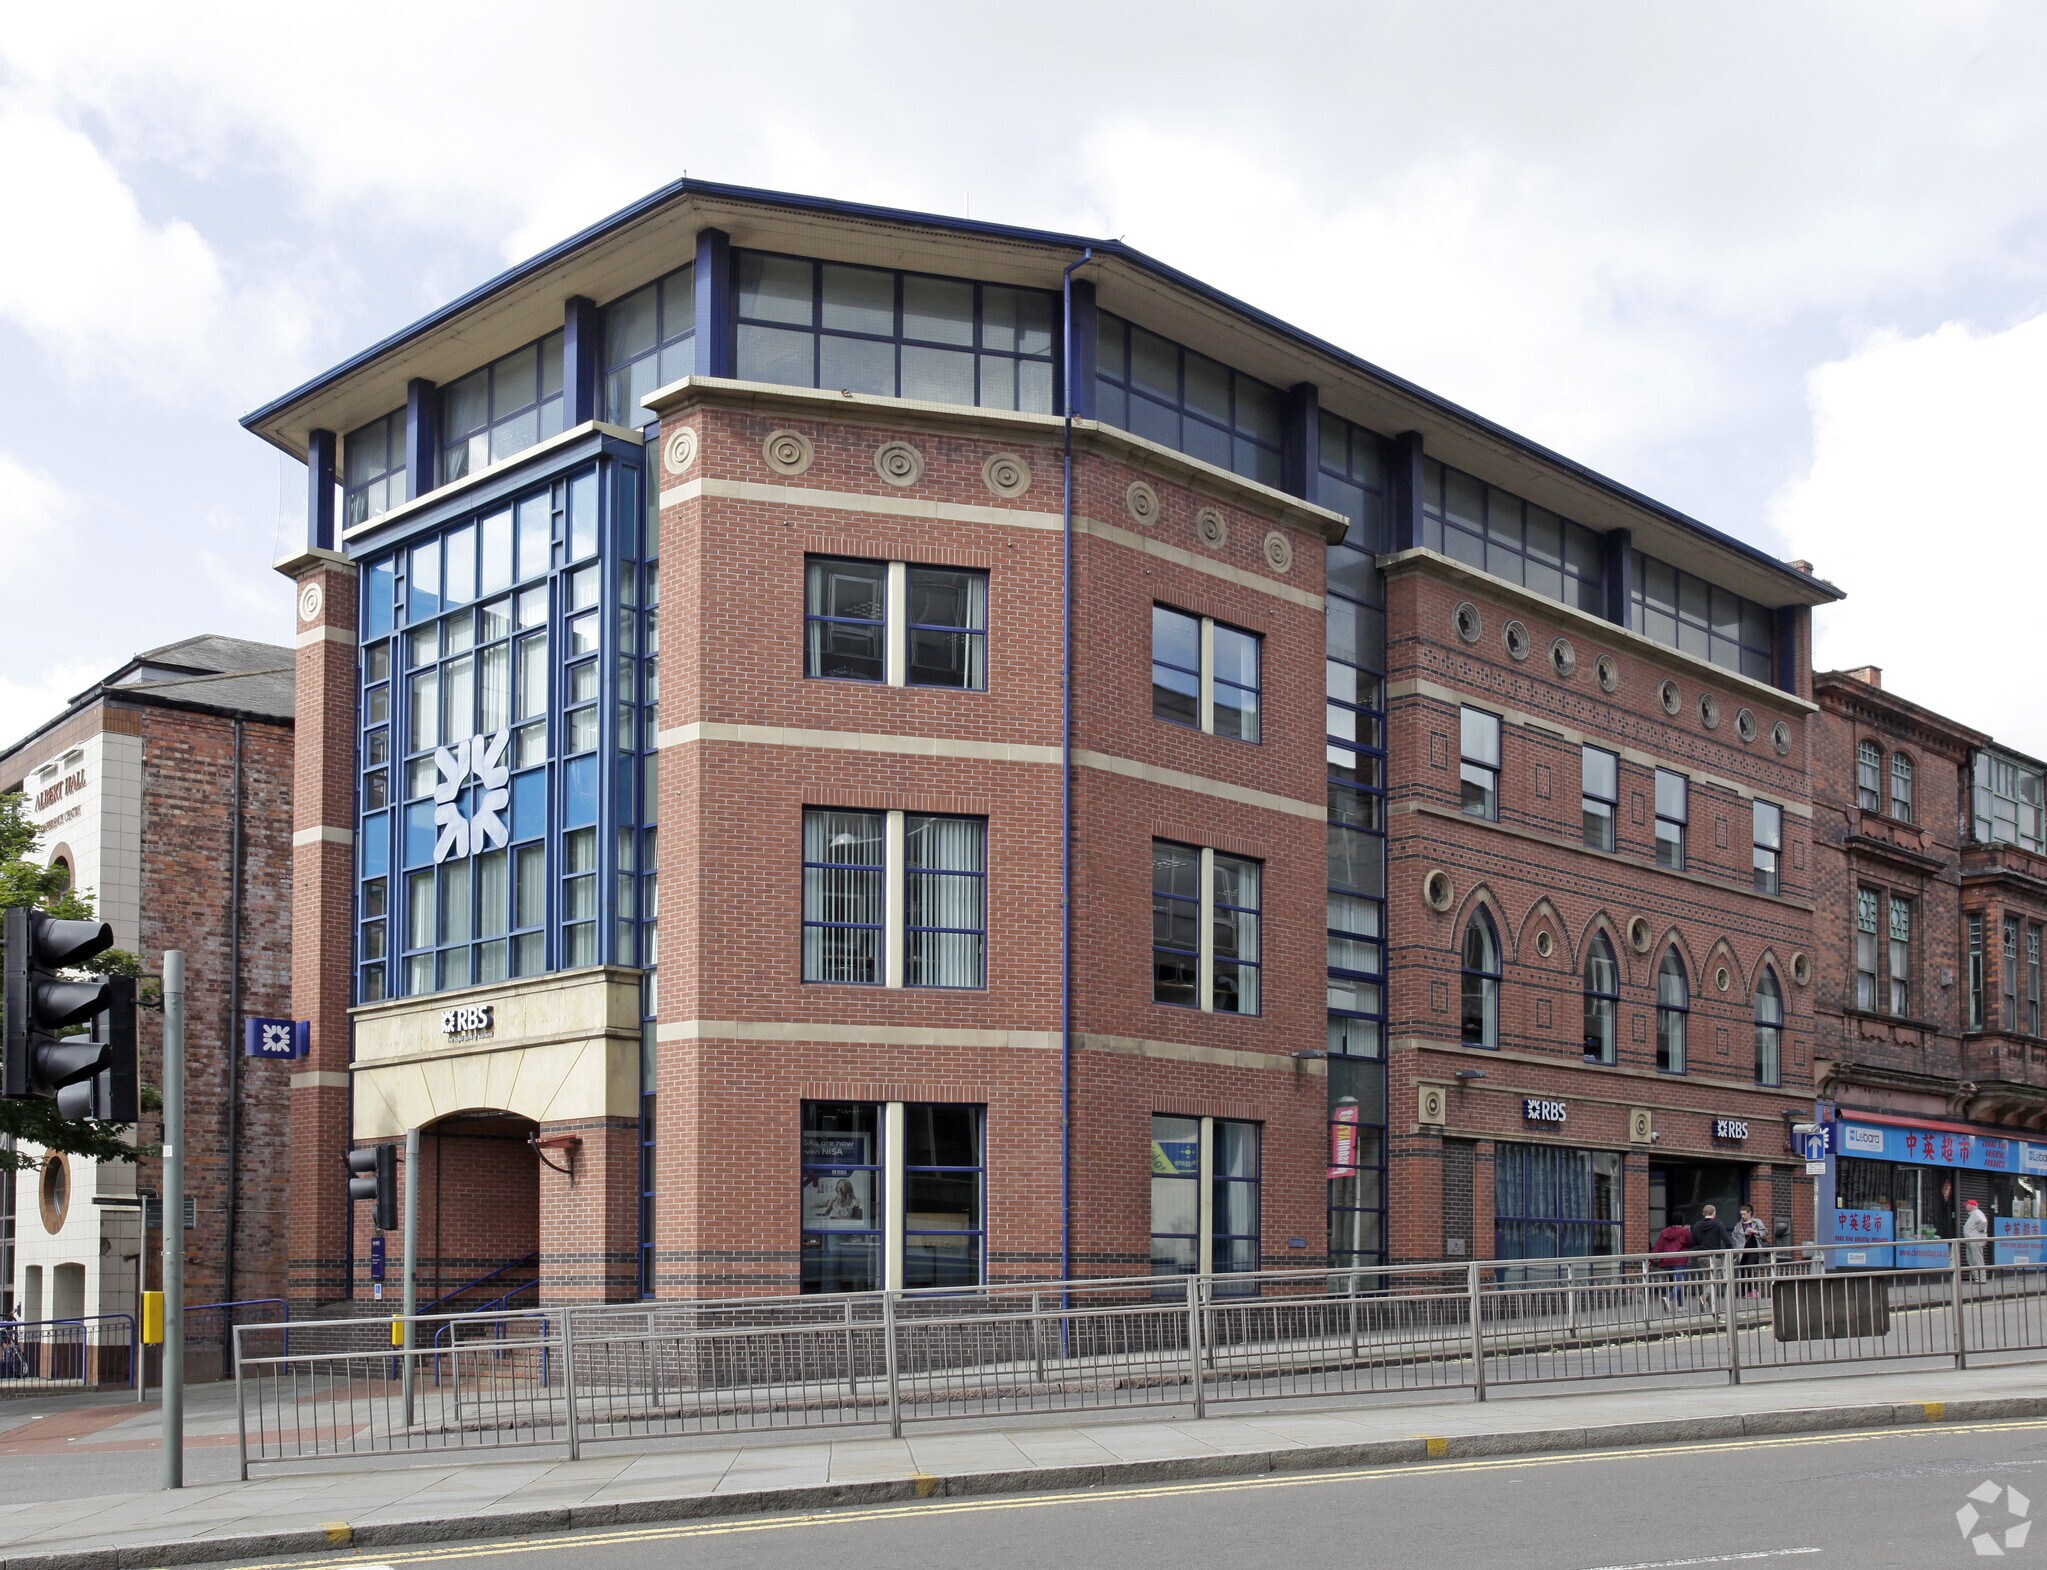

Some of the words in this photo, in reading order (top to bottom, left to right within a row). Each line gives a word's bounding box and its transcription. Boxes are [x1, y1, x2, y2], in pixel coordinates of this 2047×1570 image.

[35, 780, 64, 813] ALBERT
[65, 769, 87, 796] HALL
[457, 1005, 490, 1032] RBS
[1541, 1101, 1567, 1122] RBS
[1728, 1120, 1749, 1139] RBS
[1855, 1130, 1880, 1144] Lebara
[821, 1148, 844, 1156] NISA
[1906, 1129, 1971, 1165] 中英超市
[1838, 1211, 1884, 1233] 中英超市
